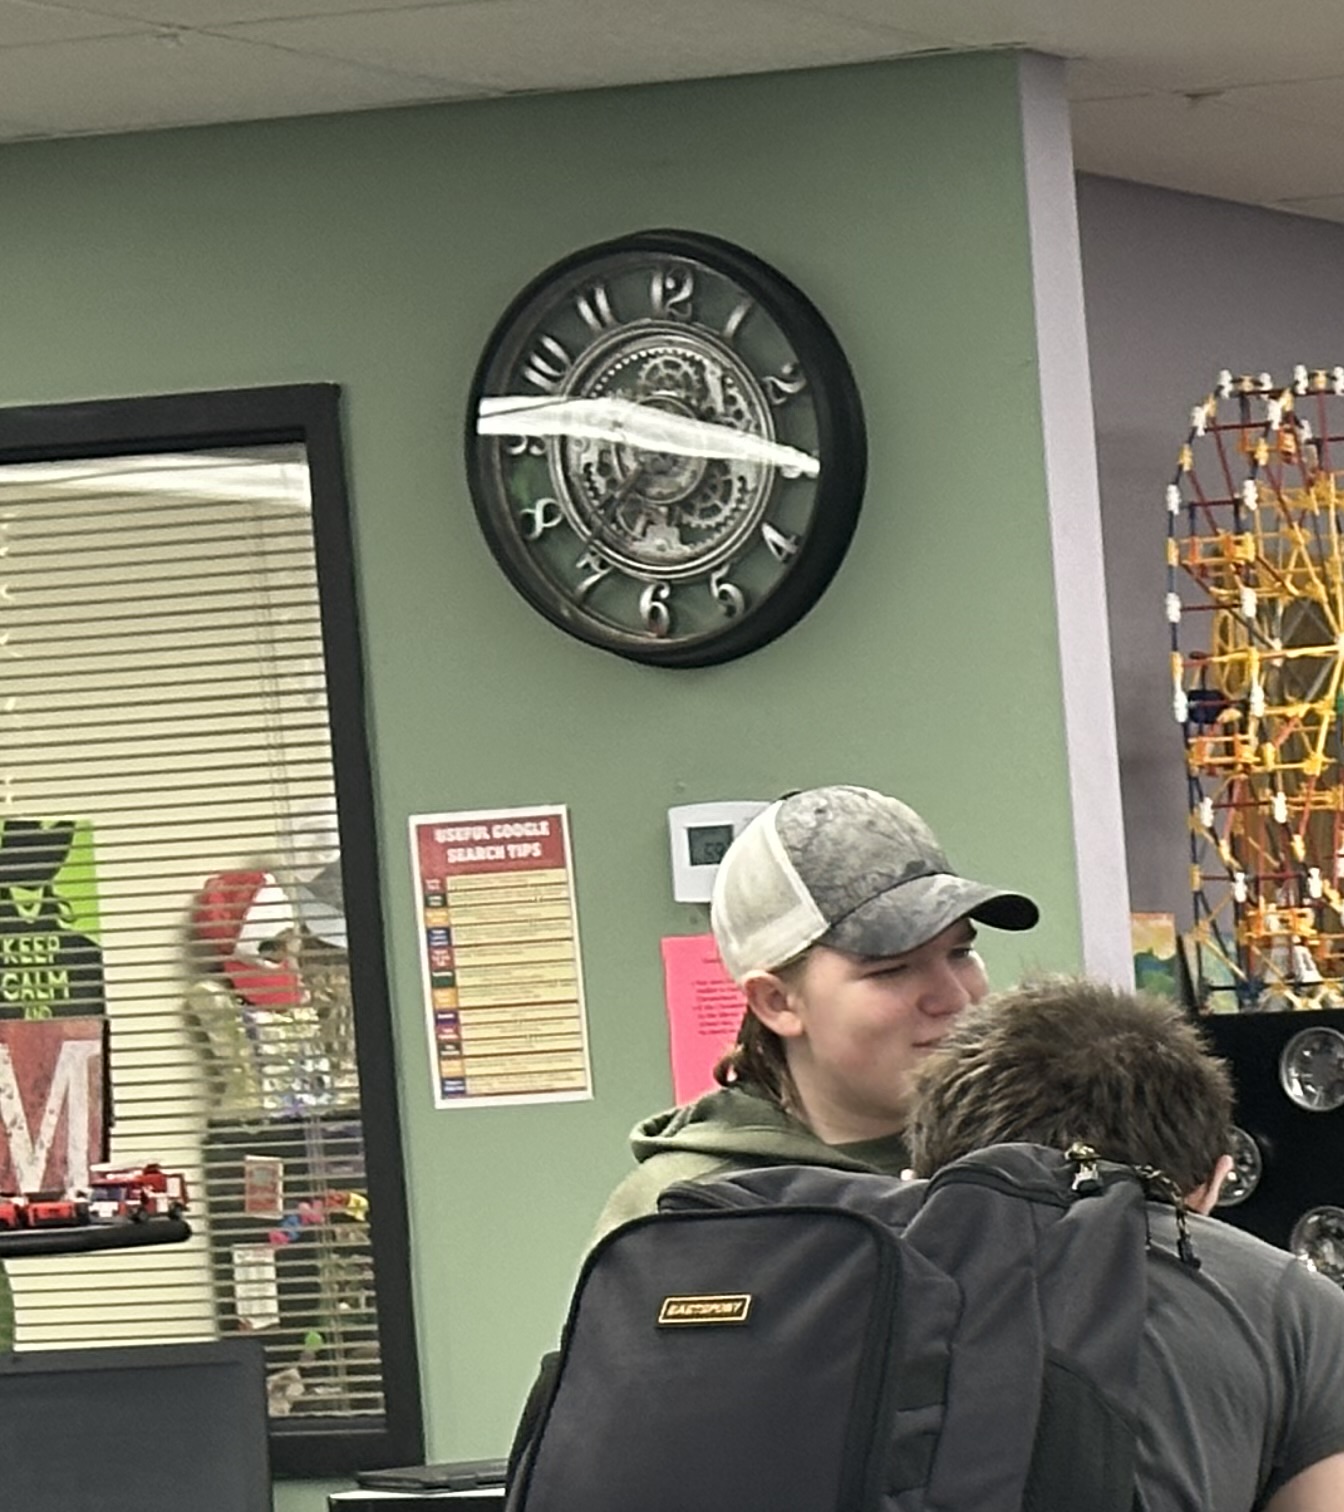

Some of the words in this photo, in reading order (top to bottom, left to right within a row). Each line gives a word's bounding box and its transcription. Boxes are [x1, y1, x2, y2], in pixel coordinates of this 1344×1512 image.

[650, 271, 694, 318] 12
[764, 362, 807, 405] 2
[520, 498, 564, 540] 8
[761, 522, 800, 564] 4
[639, 581, 671, 639] 6
[710, 563, 746, 617] 5
[434, 825, 490, 843] USEFUL
[491, 820, 550, 839] GOOGLE
[446, 844, 505, 863] SEARCH
[507, 842, 541, 859] TIPS
[2, 936, 60, 965] KEEP
[1, 969, 70, 999] CALM
